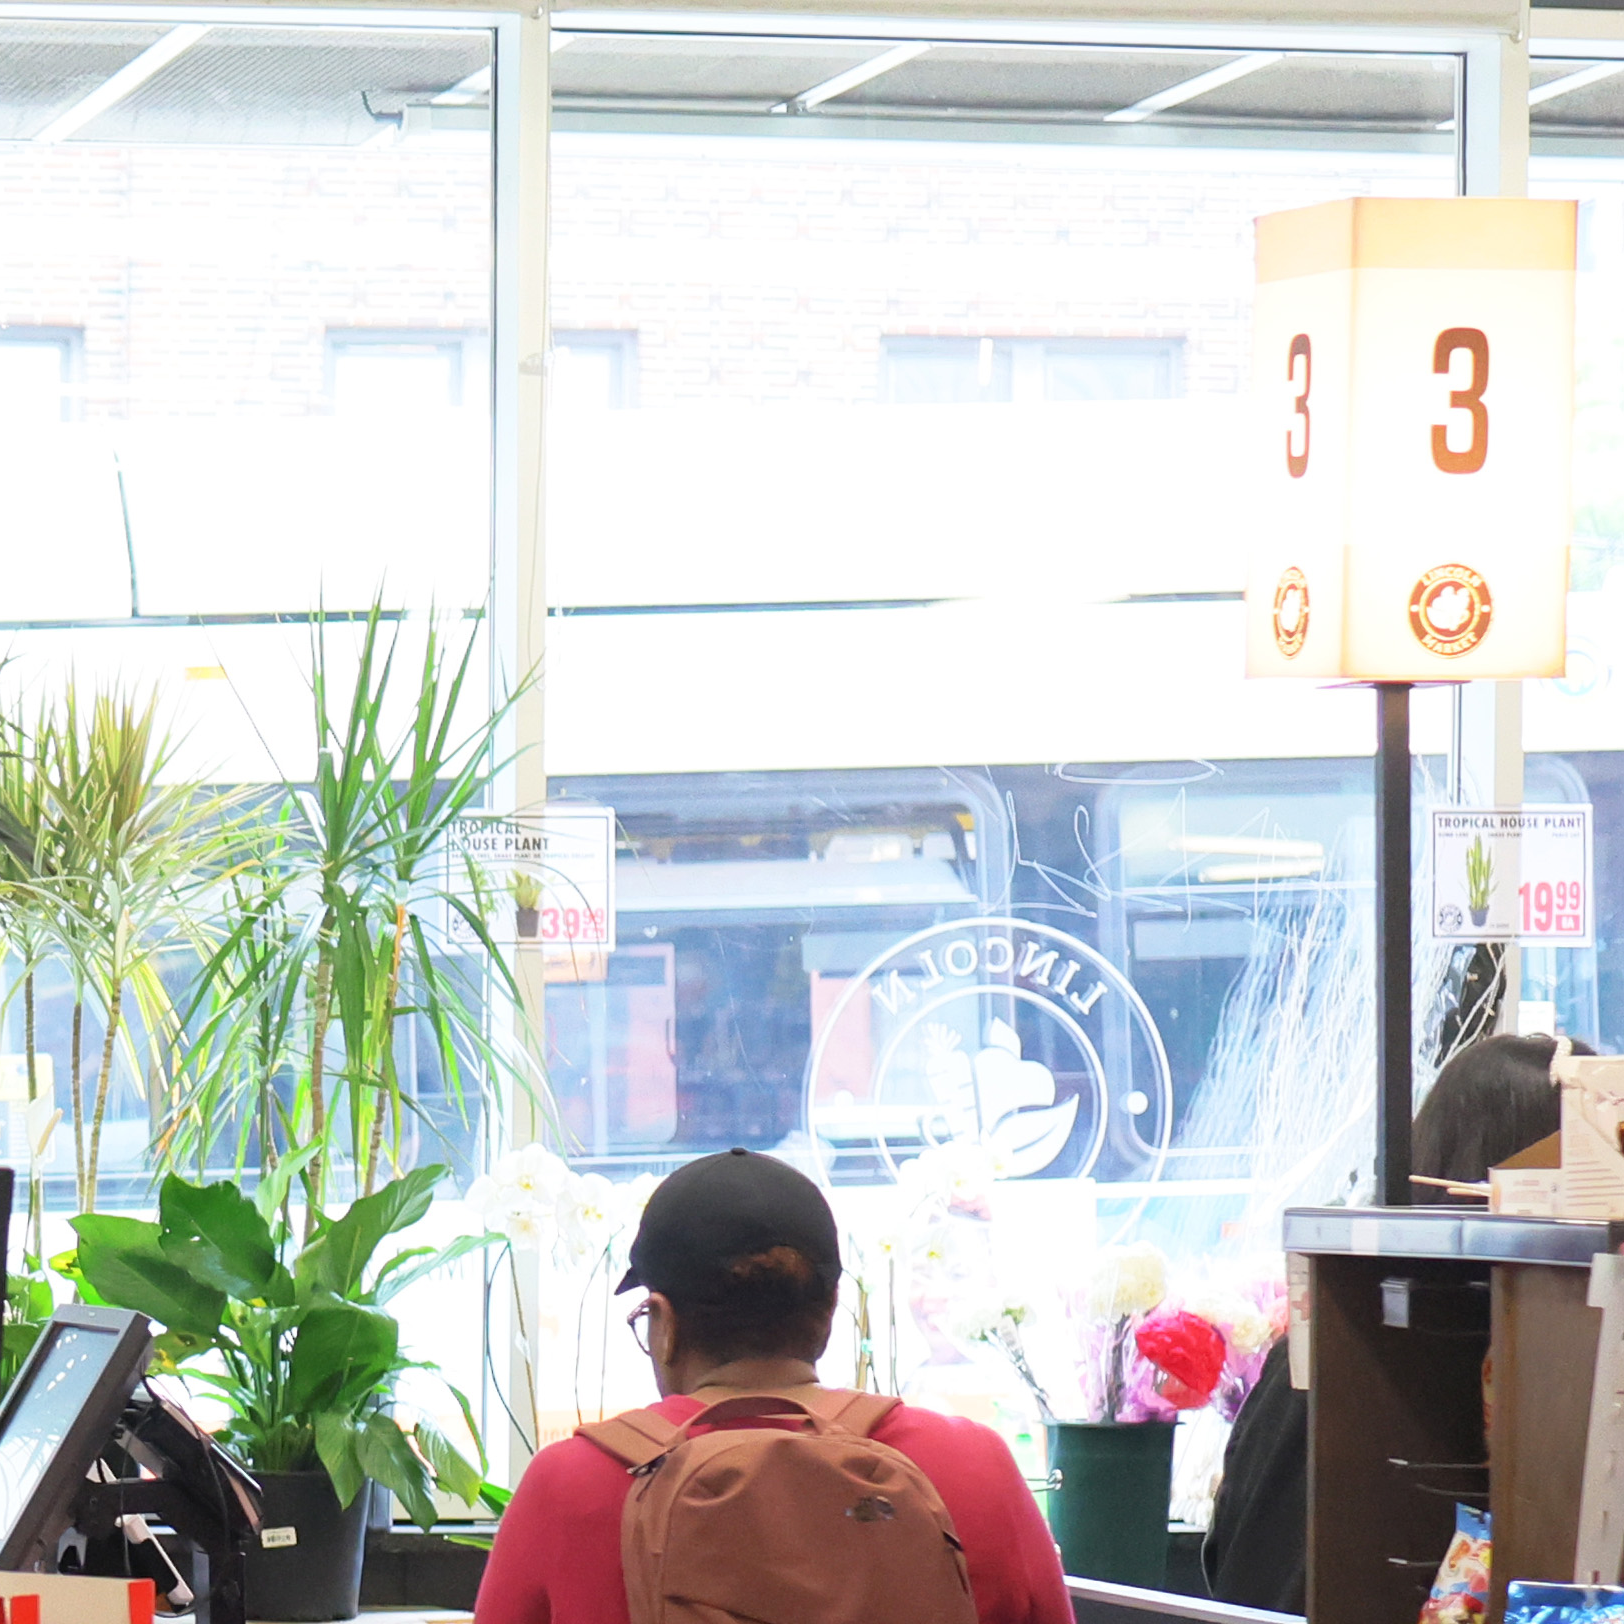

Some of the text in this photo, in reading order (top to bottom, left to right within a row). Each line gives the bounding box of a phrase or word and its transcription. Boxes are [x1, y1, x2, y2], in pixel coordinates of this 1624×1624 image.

[1286, 333, 1312, 479] 3
[1430, 327, 1490, 475] 3
[1420, 566, 1483, 588] LINCOLN
[1421, 629, 1480, 655] MARKET
[1438, 817, 1581, 829] TROPICAL HOUSE PLANT
[505, 837, 550, 850] PLANT
